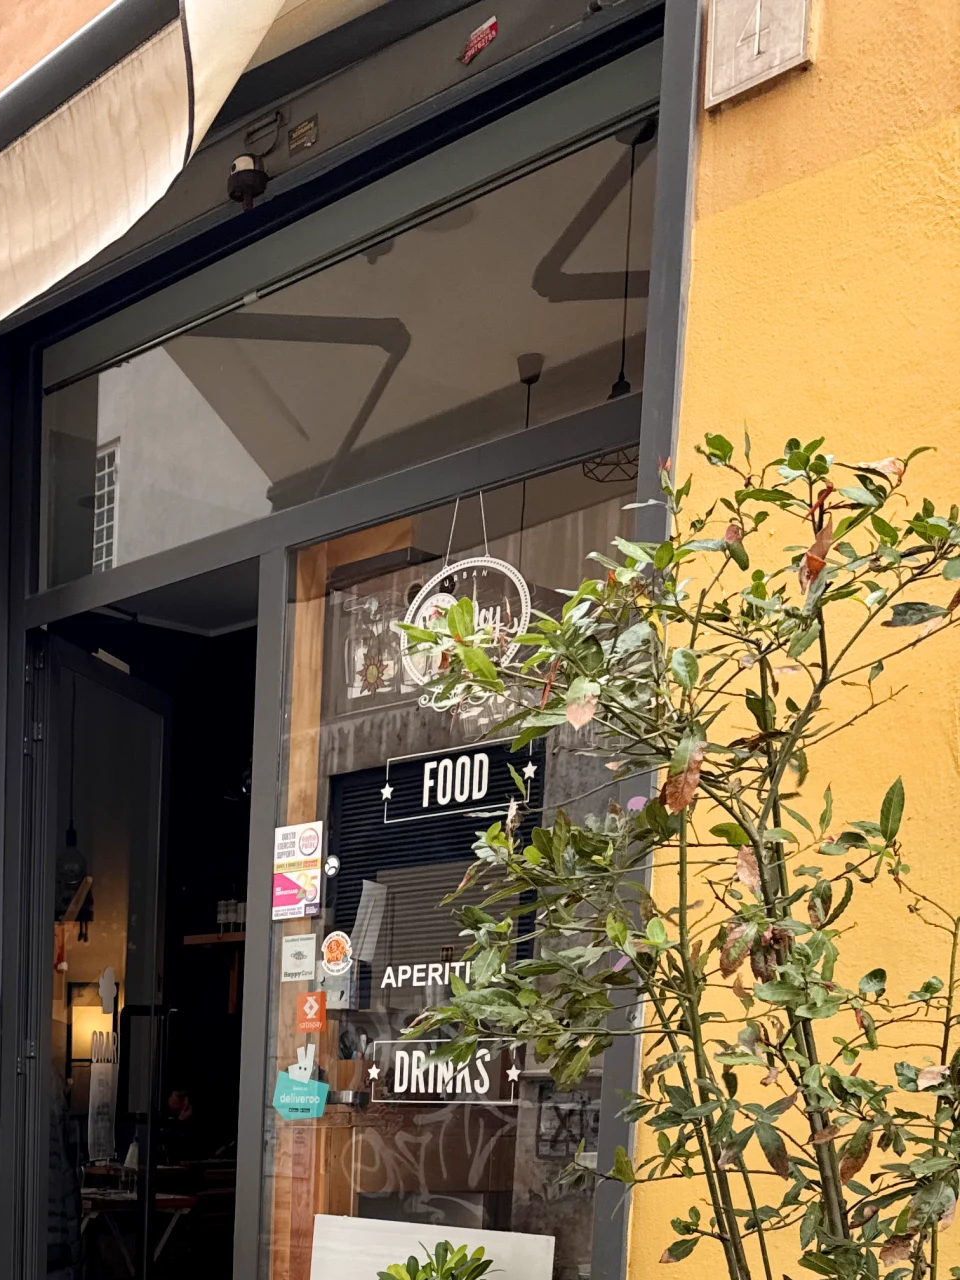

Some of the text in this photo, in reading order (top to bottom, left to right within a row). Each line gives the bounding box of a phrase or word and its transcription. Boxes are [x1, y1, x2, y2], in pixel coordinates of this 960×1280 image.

[736, 0, 770, 61] 4
[444, 569, 488, 587] URBAN
[423, 752, 489, 808] FOOD
[282, 832, 296, 841] QUESTO
[380, 960, 506, 989] APERITI
[299, 1021, 322, 1029] satispay
[91, 1030, 120, 1063] ORARI
[394, 1048, 490, 1094] DRINKS
[280, 1092, 320, 1104] deliveroo
